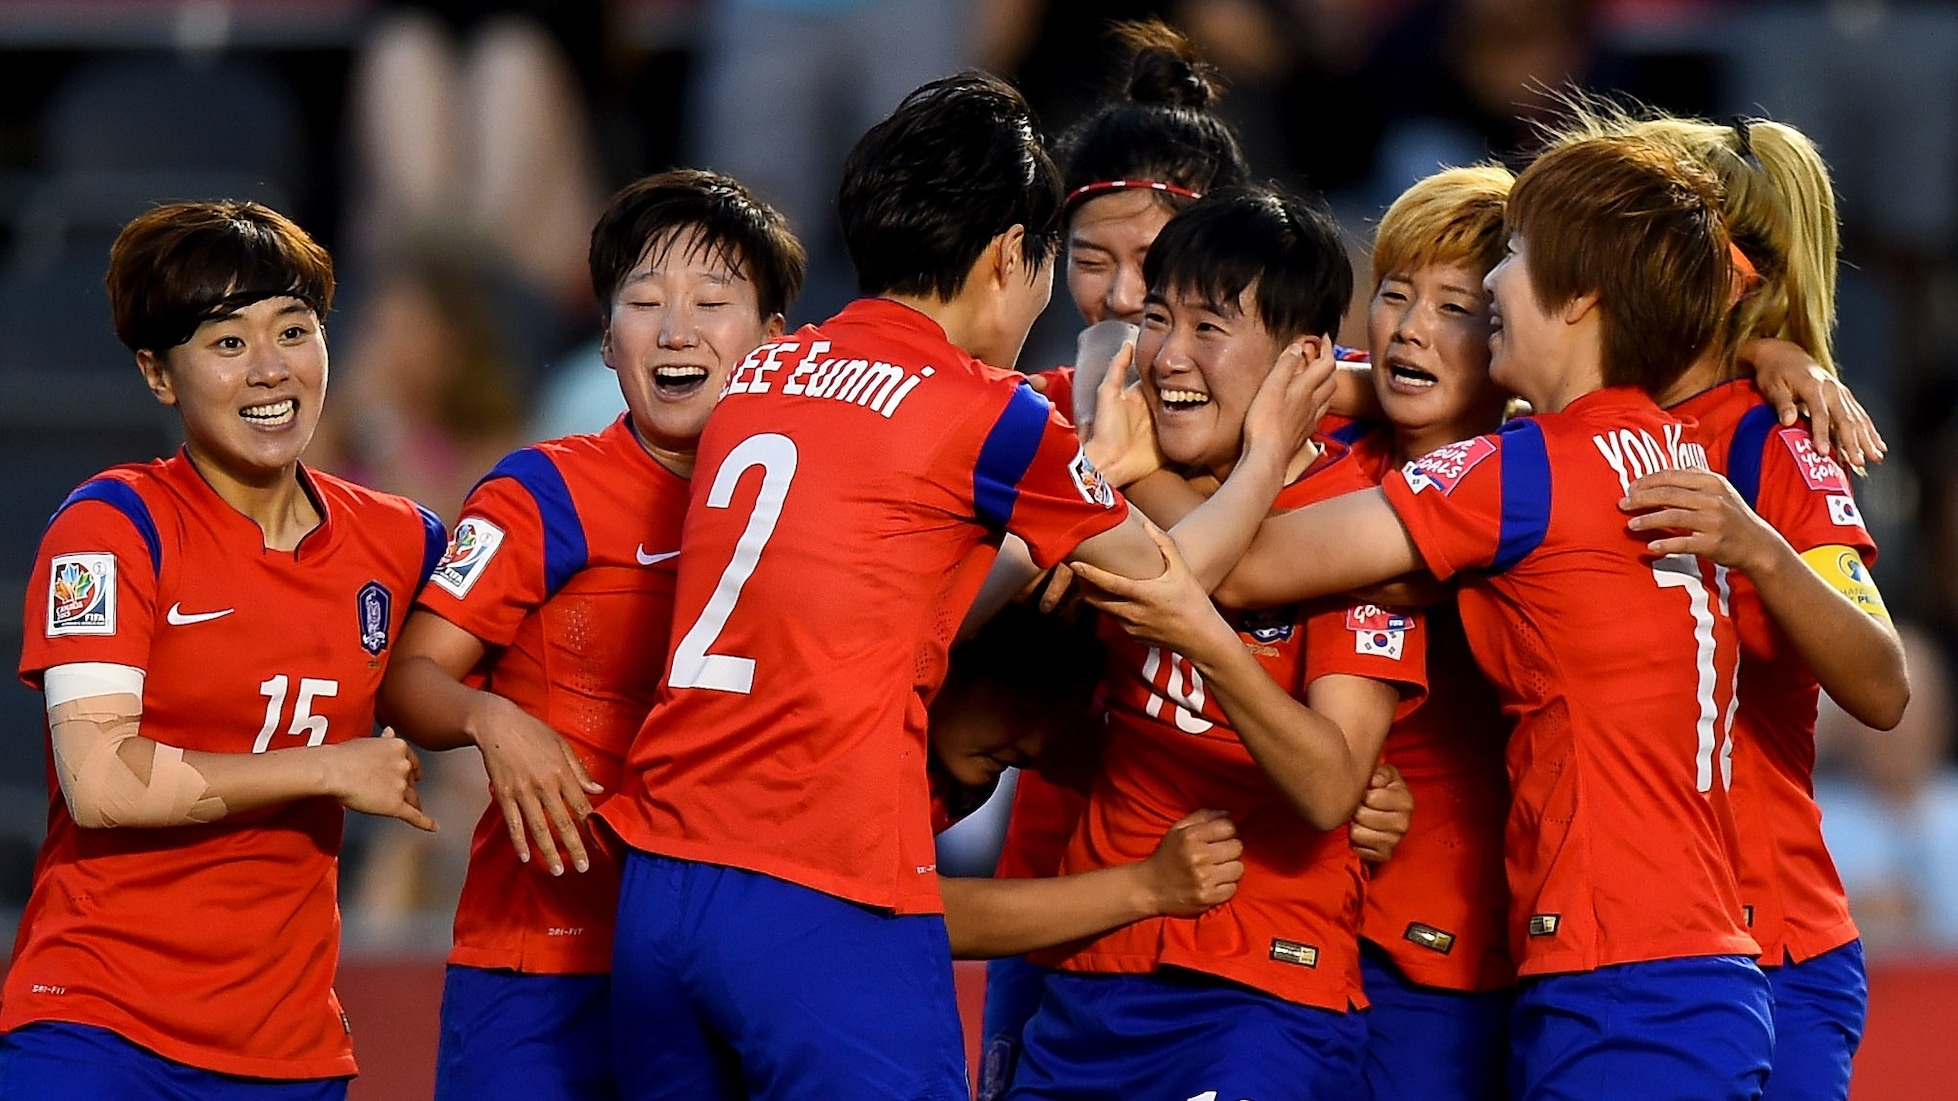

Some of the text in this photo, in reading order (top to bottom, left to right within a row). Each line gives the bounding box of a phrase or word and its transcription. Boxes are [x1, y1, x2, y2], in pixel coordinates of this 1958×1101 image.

[782, 340, 936, 418] Eunmi
[668, 432, 798, 694] 2
[252, 674, 339, 754] 15
